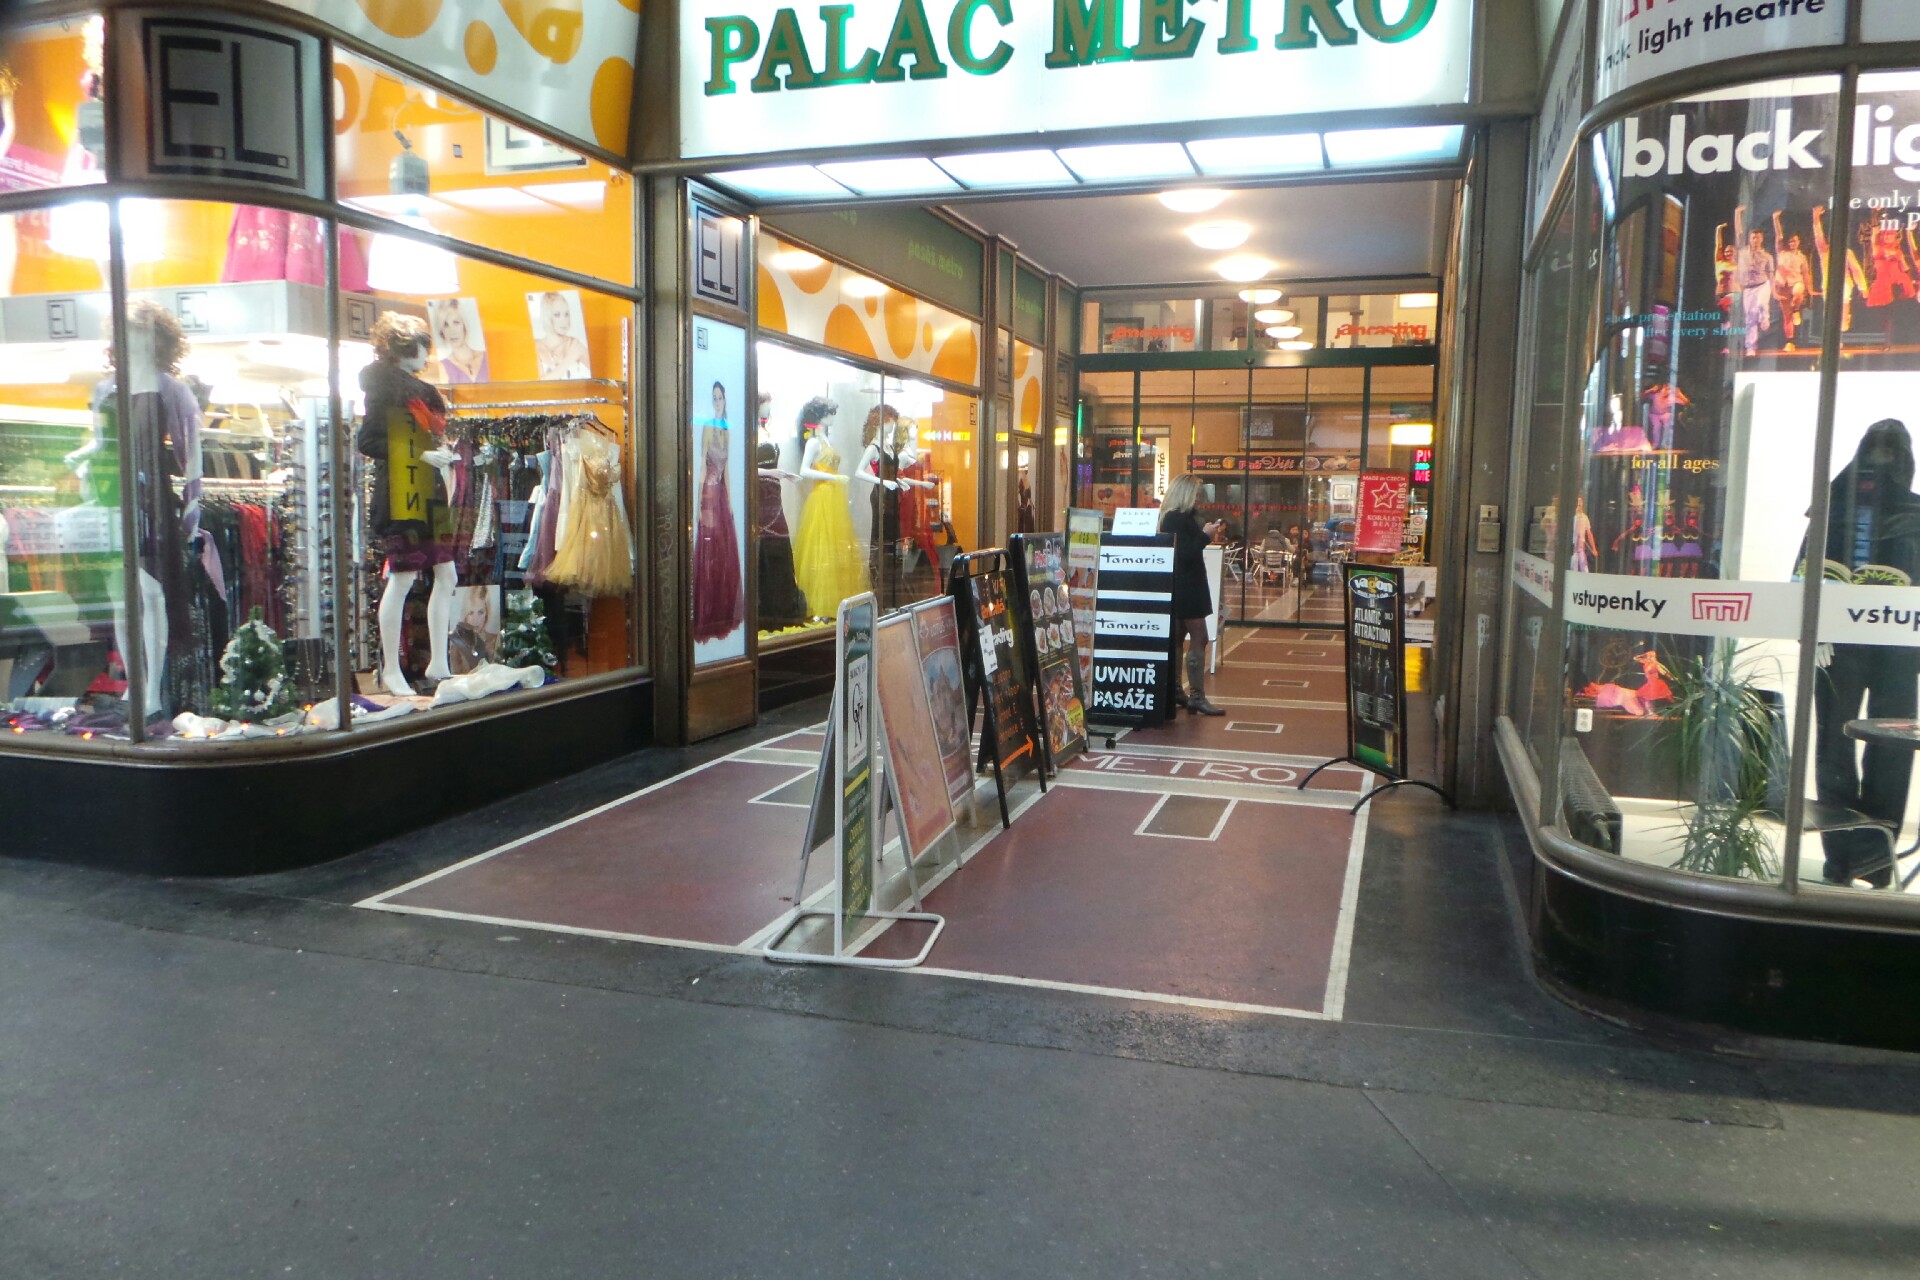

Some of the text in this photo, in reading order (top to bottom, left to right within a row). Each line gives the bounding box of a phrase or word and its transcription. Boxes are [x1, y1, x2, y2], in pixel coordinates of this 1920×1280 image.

[1638, 17, 1693, 54] light
[1703, 0, 1825, 32] theatre
[1622, 108, 1823, 178] black
[1867, 189, 1911, 213] only
[1880, 213, 1899, 231] in
[1632, 454, 1720, 474] for all ages
[1572, 589, 1668, 618] vstupenky
[1354, 623, 1391, 643] ATTRACTION
[1095, 663, 1156, 685] UVNITŘ
[1094, 687, 1155, 711] PASÁŽE
[1078, 754, 1298, 782] METRO
